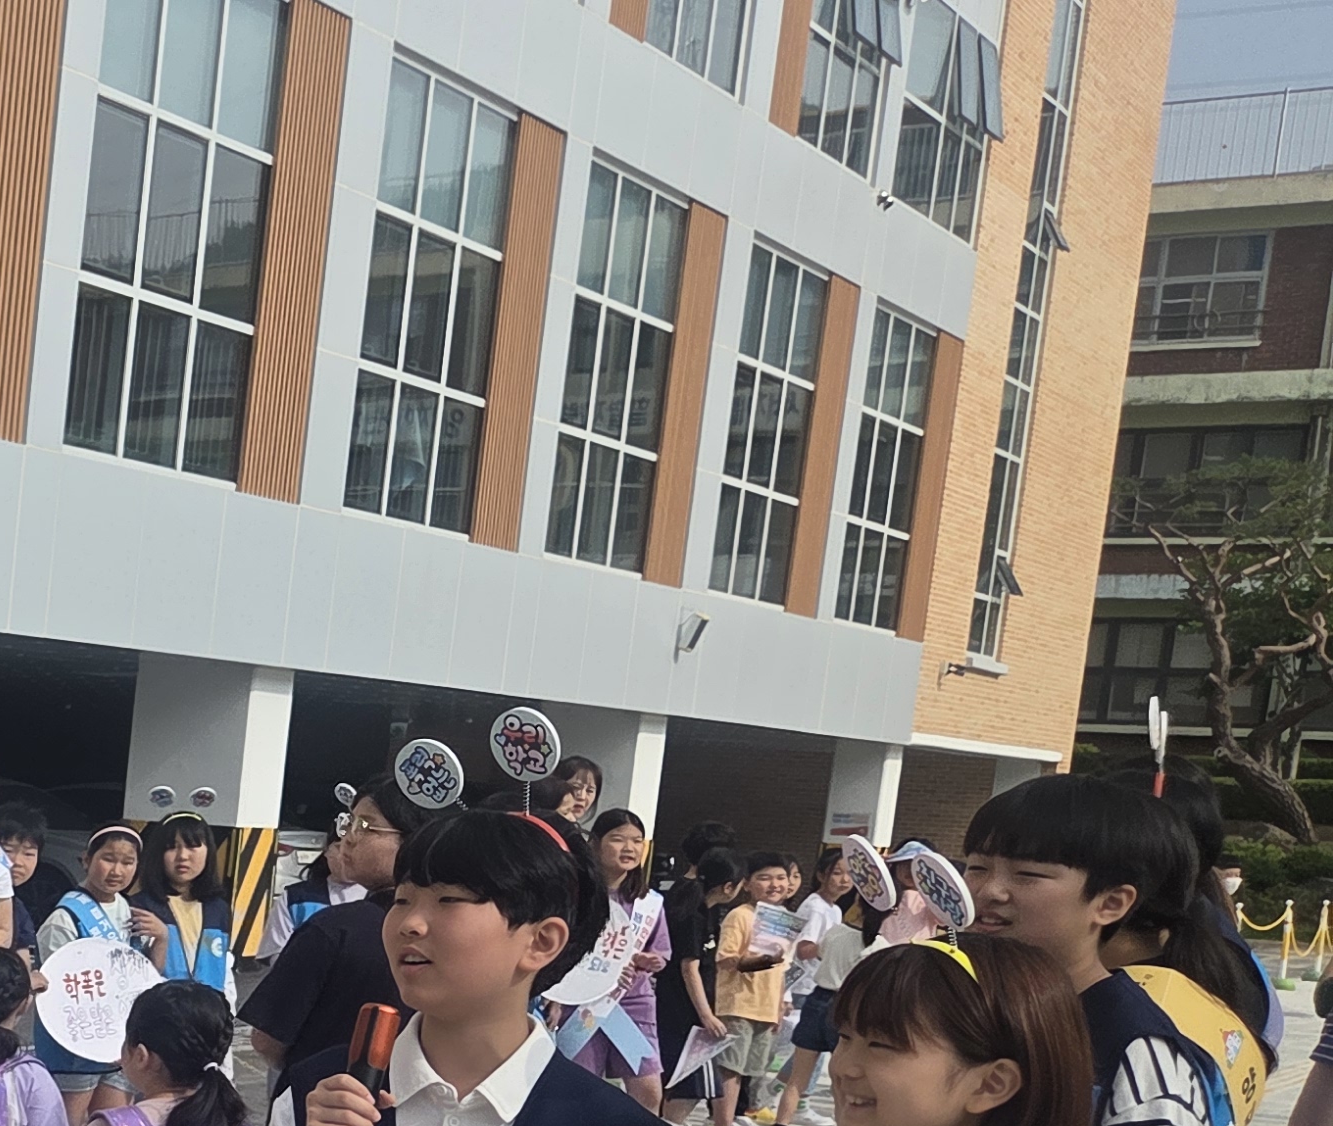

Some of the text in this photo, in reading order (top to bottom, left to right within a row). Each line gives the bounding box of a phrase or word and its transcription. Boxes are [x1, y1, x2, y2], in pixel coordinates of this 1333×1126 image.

[503, 714, 547, 743] 우리
[502, 743, 547, 776] 학교
[62, 968, 107, 1005] 학폭은
